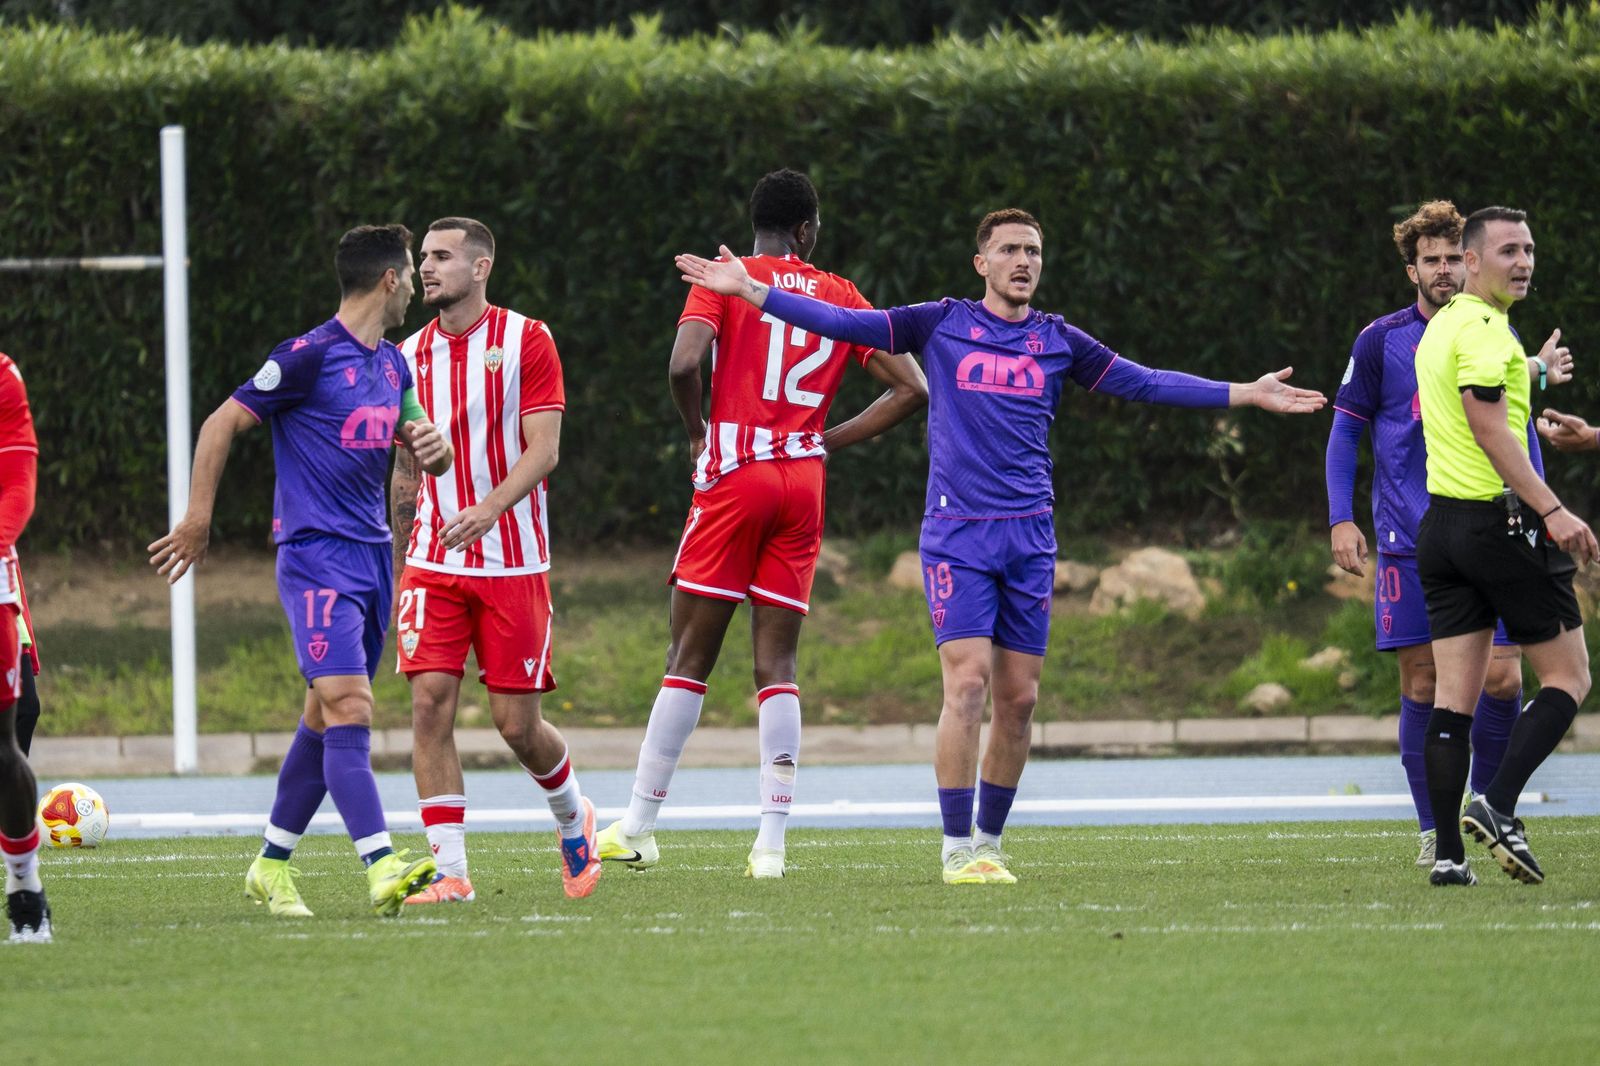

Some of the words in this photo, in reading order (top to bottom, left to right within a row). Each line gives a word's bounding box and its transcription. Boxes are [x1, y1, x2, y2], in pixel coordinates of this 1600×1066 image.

[772, 271, 818, 296] KONE
[759, 312, 834, 408] 12
[927, 562, 953, 602] 19
[1379, 566, 1401, 603] 20
[303, 588, 338, 629] 17
[397, 587, 427, 631] 21
